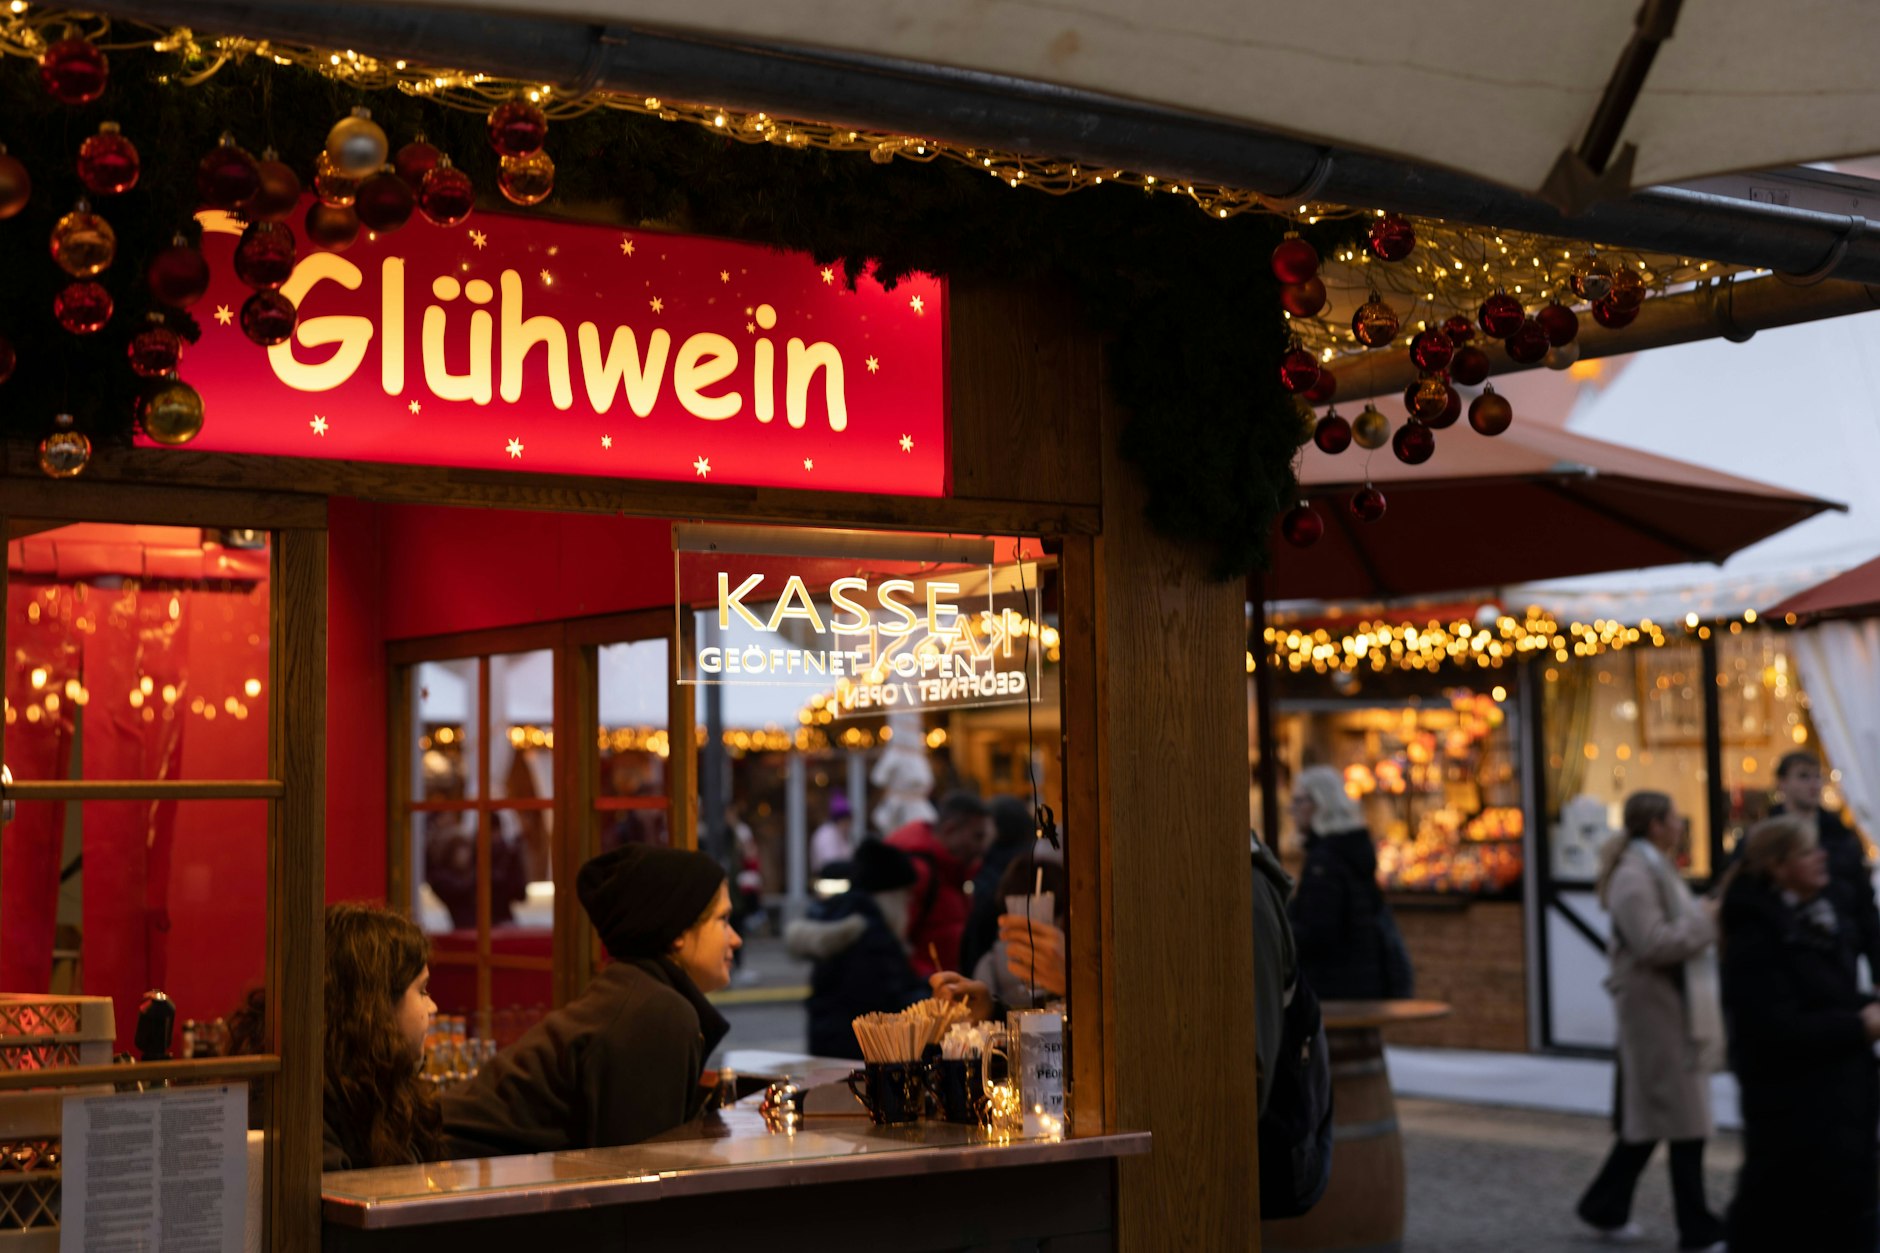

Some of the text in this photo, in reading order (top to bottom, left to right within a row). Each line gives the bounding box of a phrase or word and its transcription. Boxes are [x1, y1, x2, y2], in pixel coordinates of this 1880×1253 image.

[267, 251, 848, 432] Glühwein
[717, 571, 963, 638] KASSE
[698, 644, 863, 677] GEÖFFNET
[894, 652, 976, 679] OPEN
